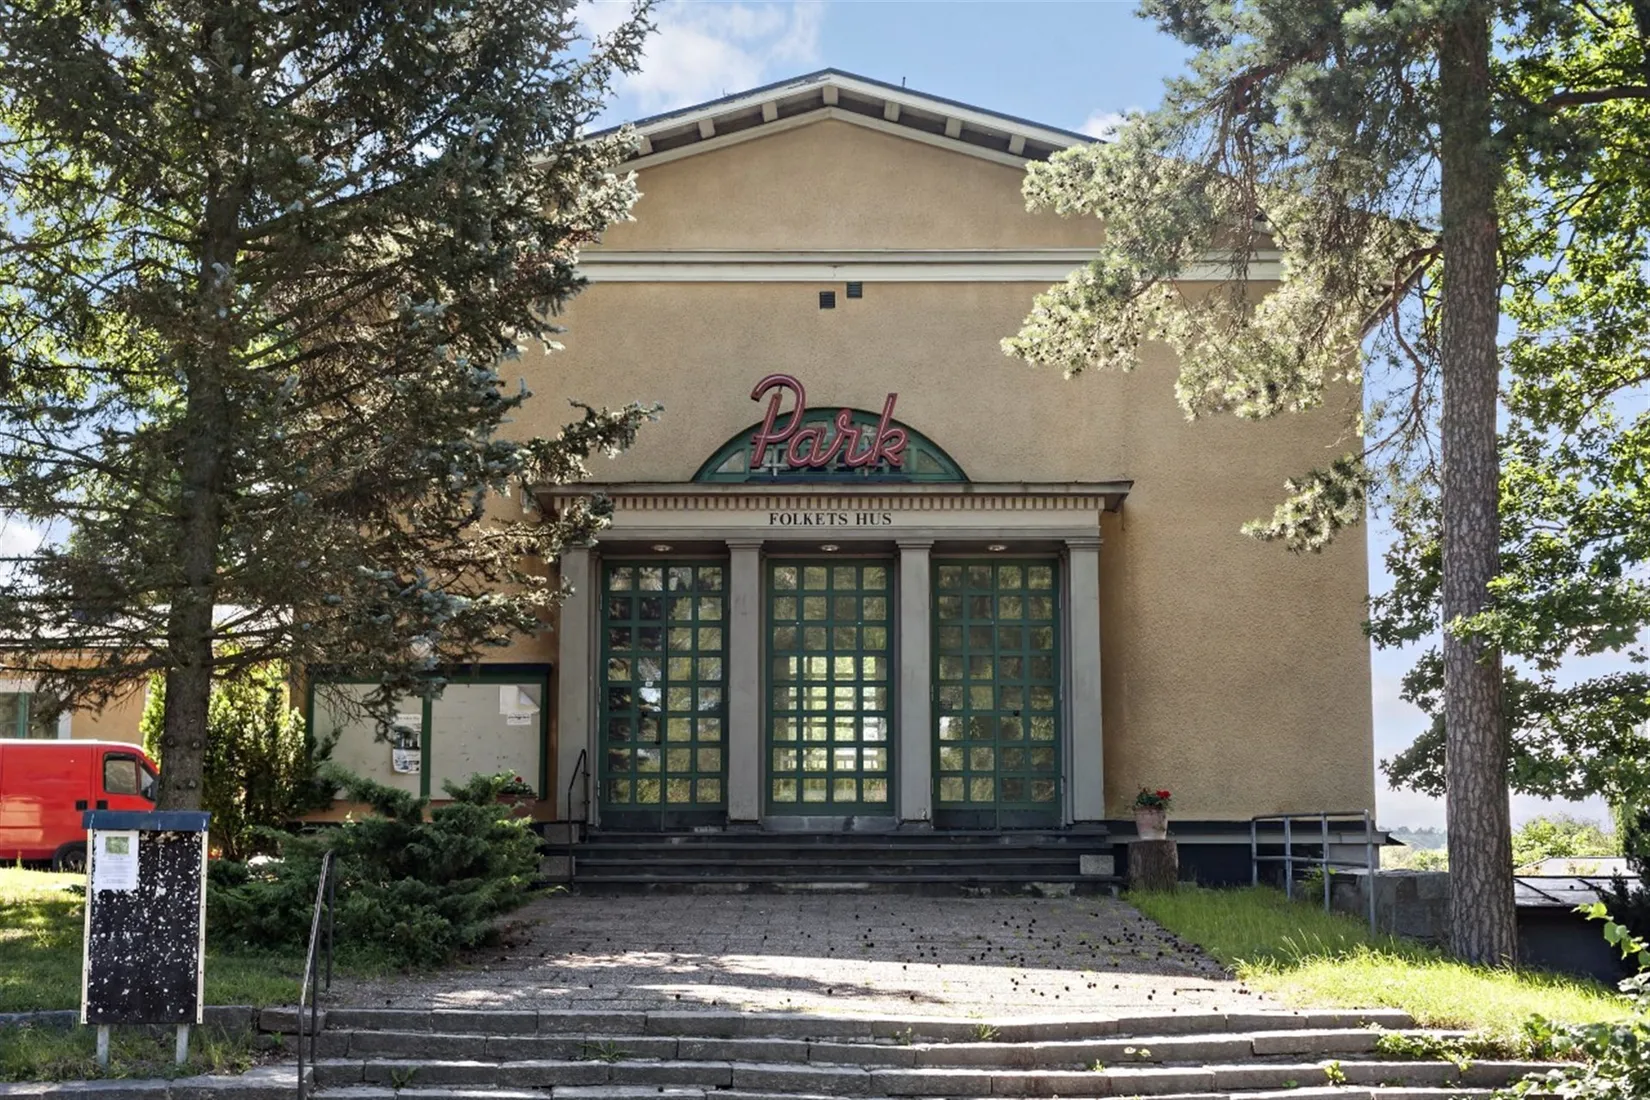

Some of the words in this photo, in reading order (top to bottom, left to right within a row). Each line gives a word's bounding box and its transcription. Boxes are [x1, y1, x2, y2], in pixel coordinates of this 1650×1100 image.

[750, 373, 909, 469] Park
[769, 512, 848, 526] FOLKETS
[856, 512, 892, 526] HUS
